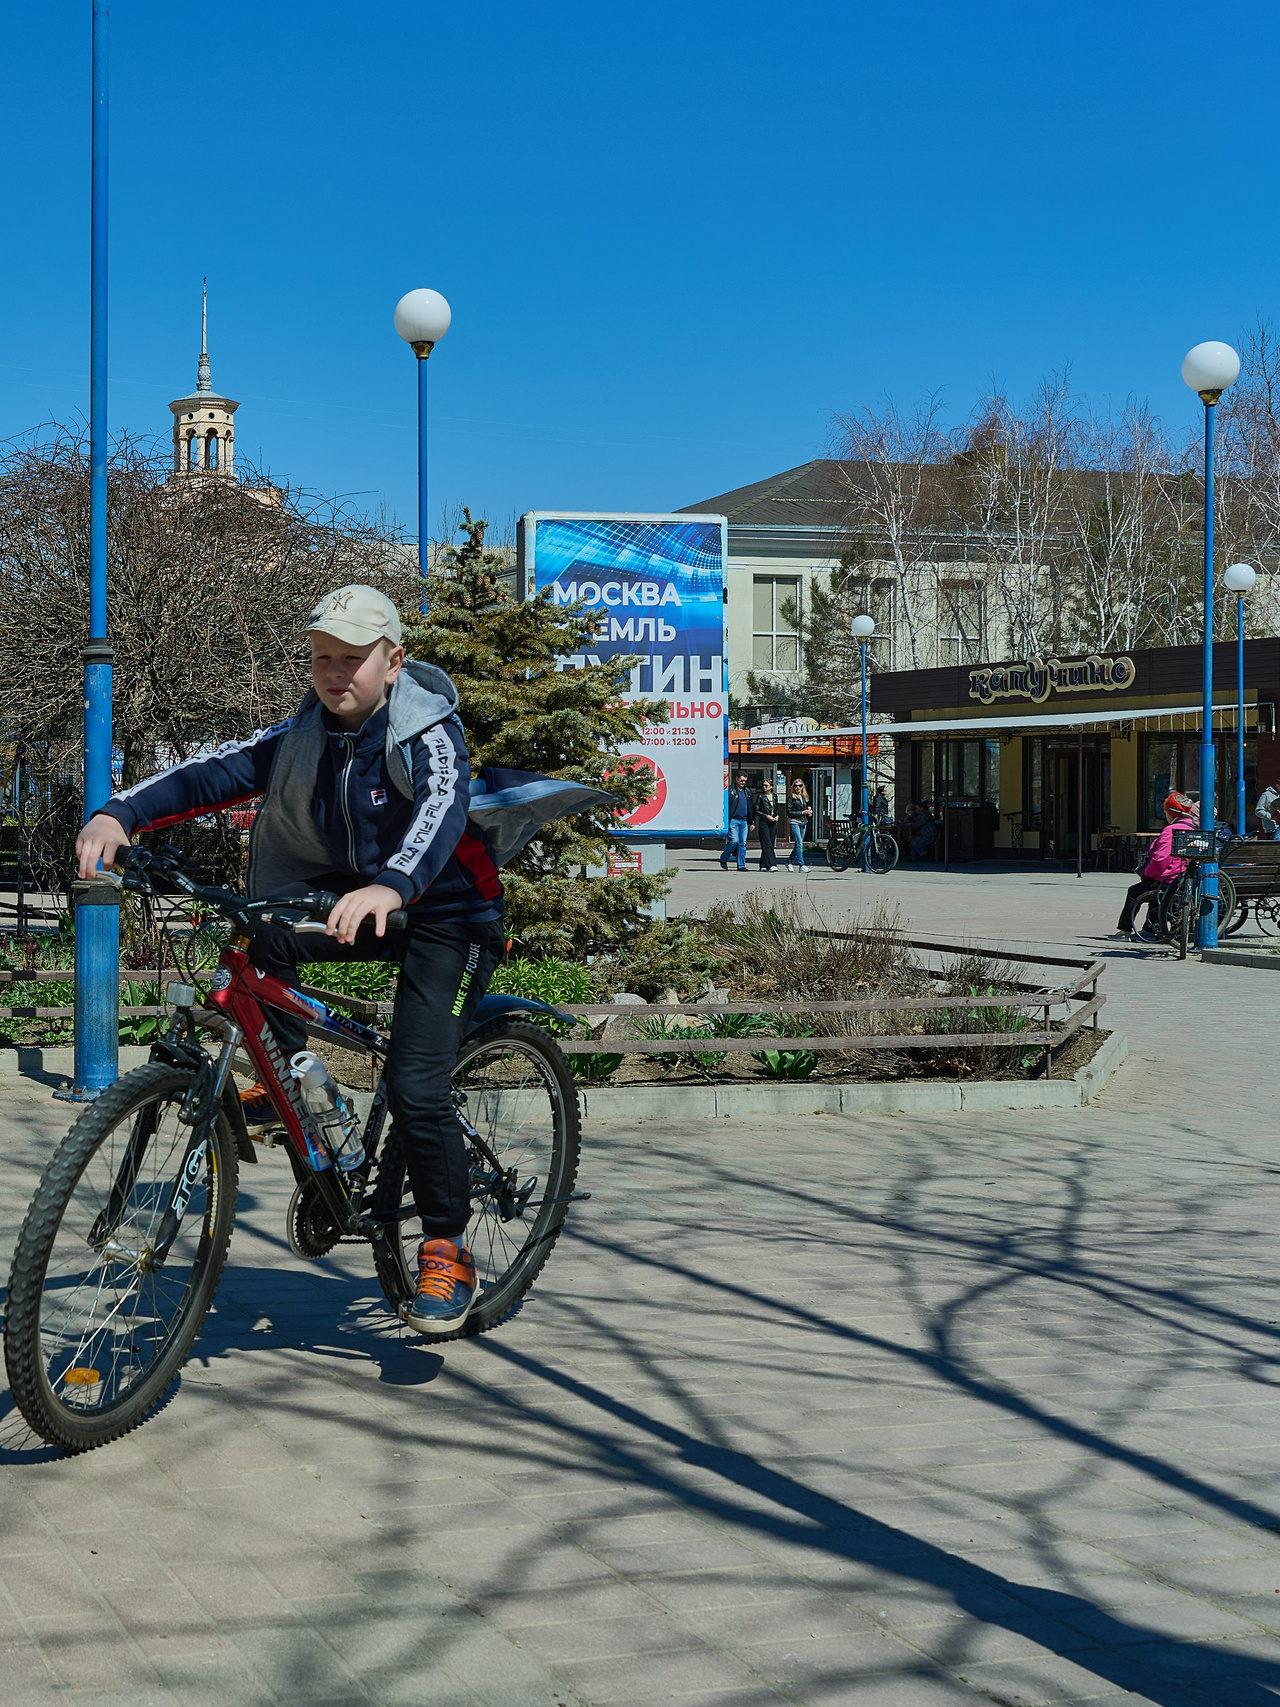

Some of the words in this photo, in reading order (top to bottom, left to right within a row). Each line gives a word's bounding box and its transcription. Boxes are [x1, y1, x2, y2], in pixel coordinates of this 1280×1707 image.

[553, 580, 682, 607] МОСКВА
[570, 617, 676, 642] ЕМЛЬ
[554, 655, 723, 693] ТИН
[641, 727, 665, 736] 12:00
[671, 727, 696, 736] 21:30
[641, 738, 665, 746] 07:00
[673, 738, 697, 746] 12:00
[465, 942, 481, 974] FUTURE
[460, 971, 472, 989] THE
[451, 988, 468, 1017] MAKE
[417, 1257, 454, 1274] EOX
